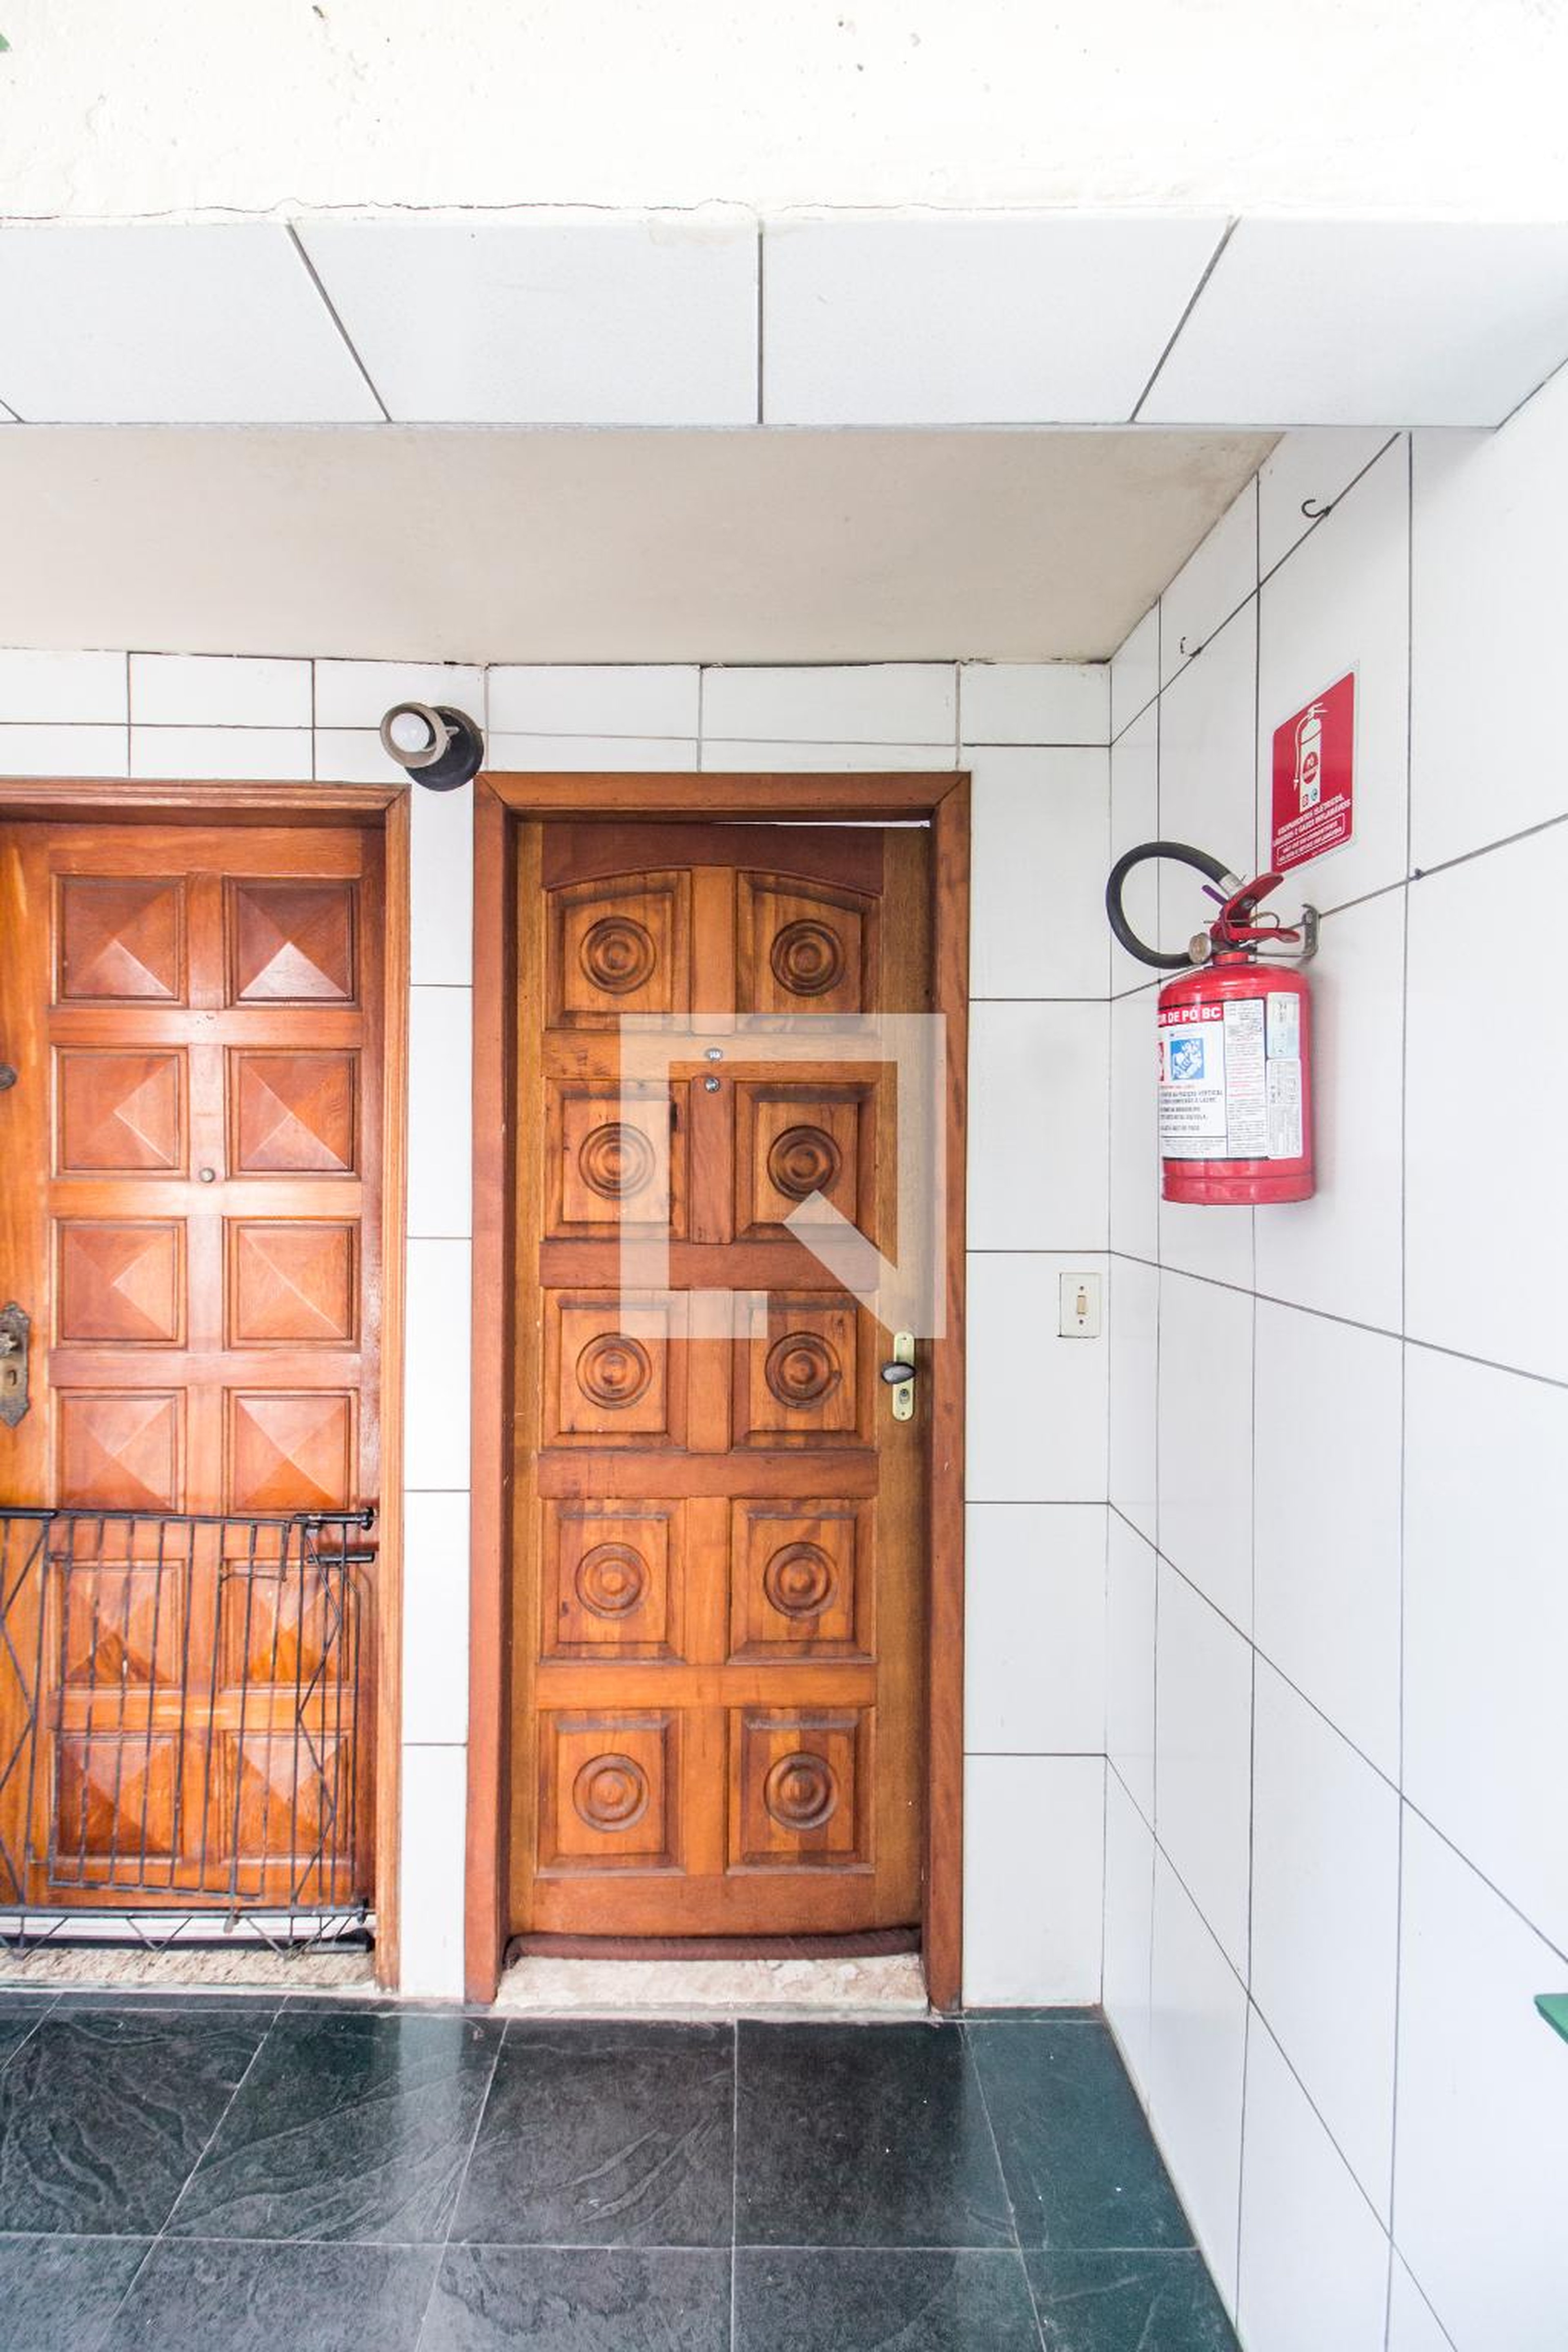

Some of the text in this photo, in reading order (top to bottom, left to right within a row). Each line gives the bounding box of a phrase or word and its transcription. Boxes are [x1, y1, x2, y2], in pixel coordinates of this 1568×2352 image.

[1168, 1011, 1180, 1023] DE
[1182, 1005, 1198, 1021] PÓ
[1202, 1007, 1221, 1019] BC
